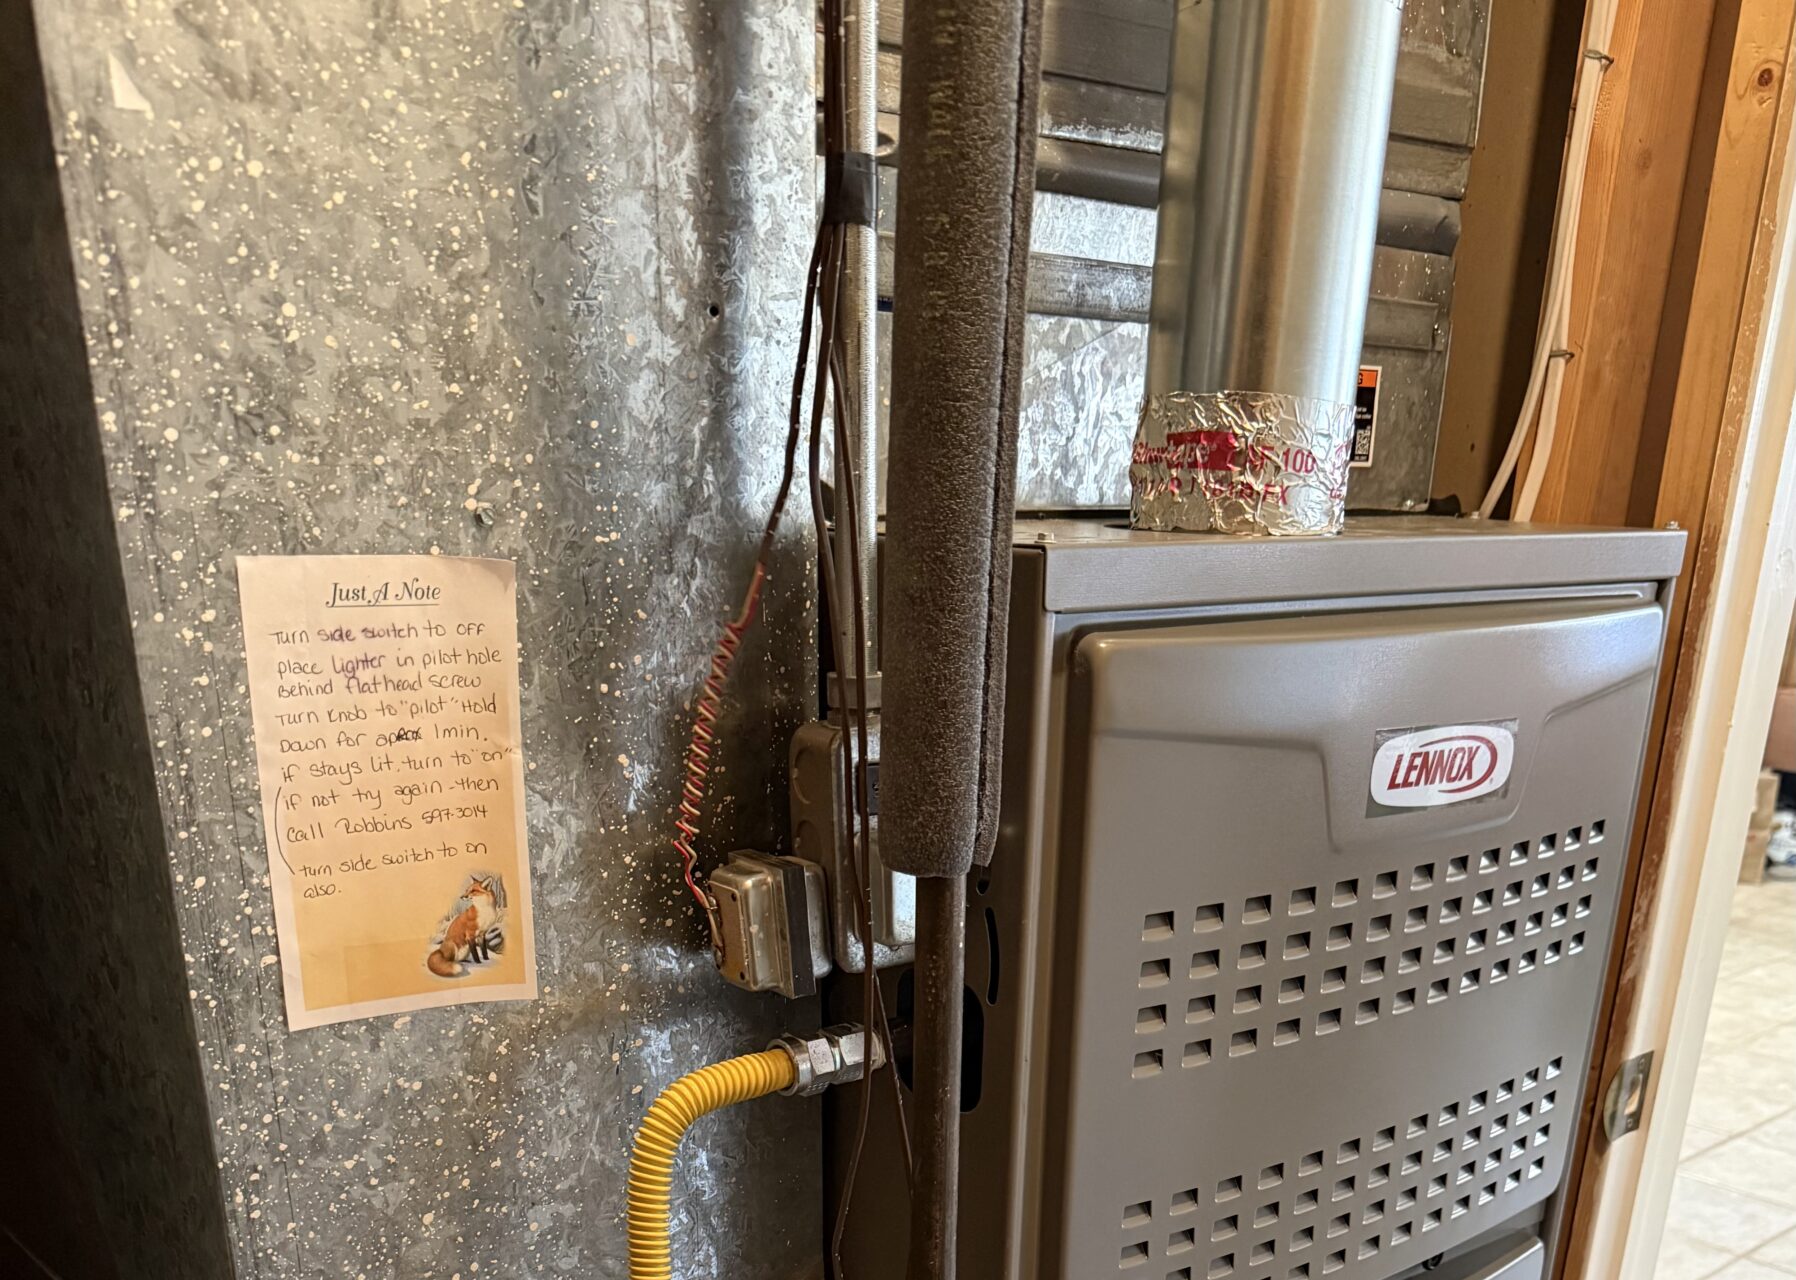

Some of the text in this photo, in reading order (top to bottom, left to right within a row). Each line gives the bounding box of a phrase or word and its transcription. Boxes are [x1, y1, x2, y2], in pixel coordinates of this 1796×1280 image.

[1282, 446, 1317, 475] 100
[325, 577, 441, 608] Just A Note
[317, 622, 357, 642] side
[361, 622, 419, 640] switch
[423, 618, 447, 638] to
[277, 659, 323, 684] place
[396, 647, 415, 668] in
[422, 648, 462, 668] pilot
[466, 647, 503, 666] hole
[428, 674, 482, 689] screw
[375, 701, 399, 717] to
[336, 731, 367, 748] for
[281, 764, 301, 783] if
[309, 757, 364, 787] stays
[401, 754, 443, 771] turn
[1386, 744, 1482, 791] LENNOX
[283, 793, 302, 812] if
[312, 789, 341, 807] not
[352, 787, 383, 811] try
[393, 780, 443, 806] again
[334, 812, 413, 834] Robbins
[338, 852, 378, 873] side
[381, 844, 435, 866] switch
[436, 841, 459, 858] to
[465, 841, 488, 856] on
